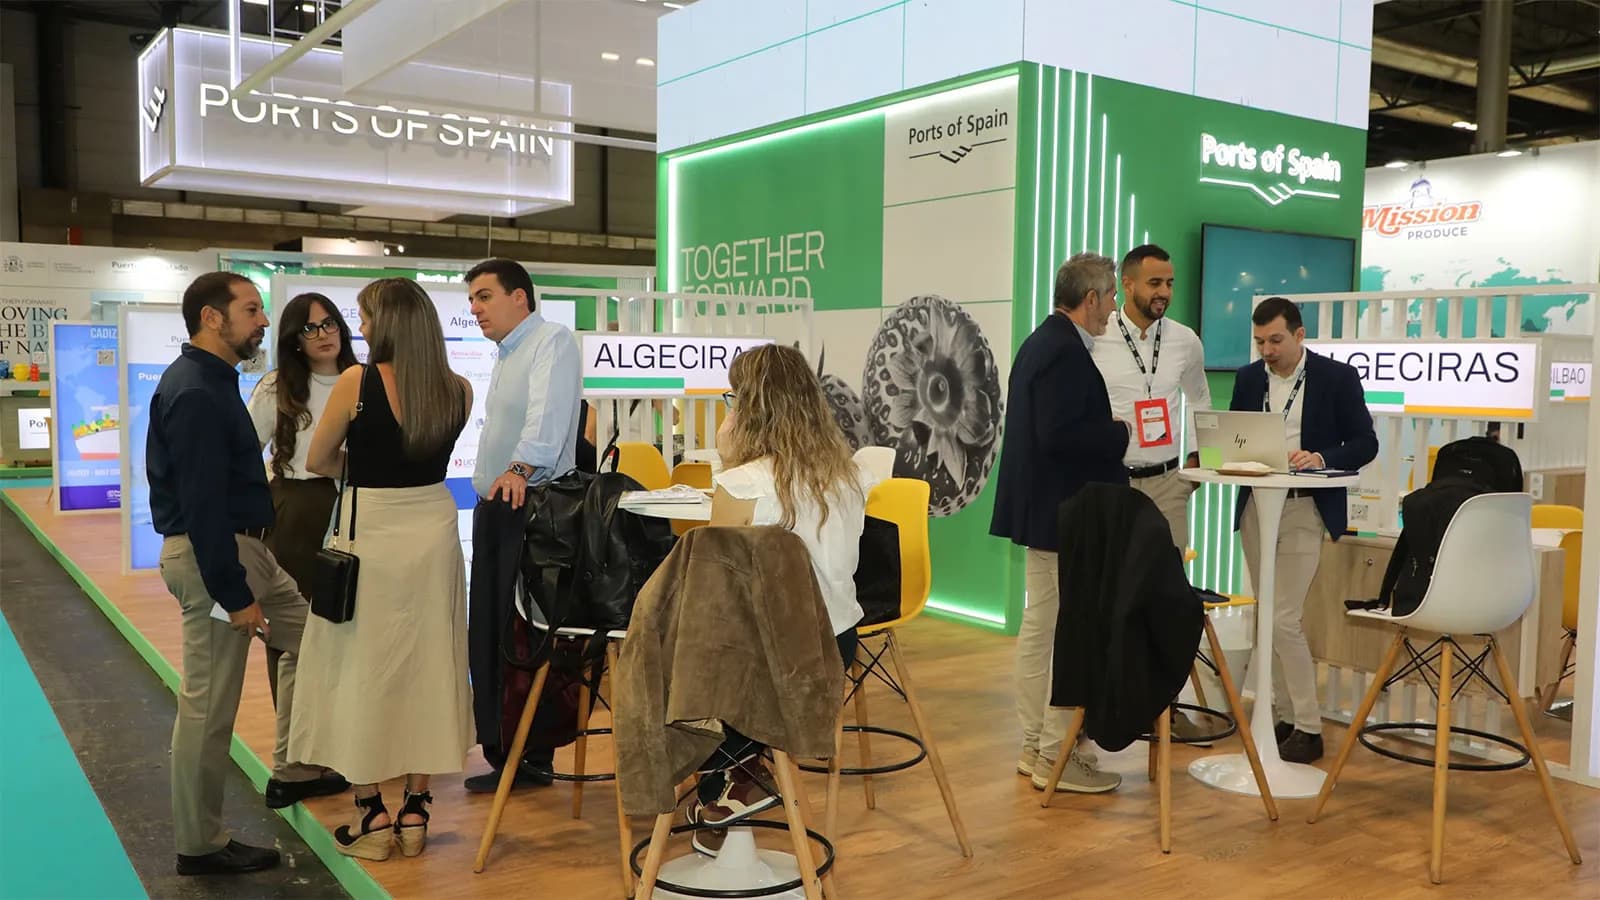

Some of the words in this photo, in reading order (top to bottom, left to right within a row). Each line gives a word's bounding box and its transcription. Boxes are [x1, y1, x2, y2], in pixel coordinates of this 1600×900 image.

[200, 83, 359, 135] PORTS
[371, 105, 430, 141] OF
[439, 113, 553, 156] SPAIN
[908, 124, 943, 145] Ports
[947, 116, 962, 137] of
[967, 108, 1008, 136] Spain
[1202, 132, 1257, 170] Ports
[1260, 144, 1285, 174] of
[1287, 148, 1341, 184] Spain
[1362, 203, 1480, 236] Mission
[1407, 227, 1468, 241] PRODUCE
[680, 230, 825, 282] TOGETHER
[1, 305, 68, 321] OVING
[450, 316, 480, 329] Algec
[0, 323, 26, 338] HE
[0, 340, 11, 354] F
[17, 340, 48, 354] NA
[594, 342, 743, 370] ALGECIR
[138, 372, 161, 382] Pue
[1330, 351, 1520, 383] GECIRAS
[1551, 367, 1586, 385] ILBAO
